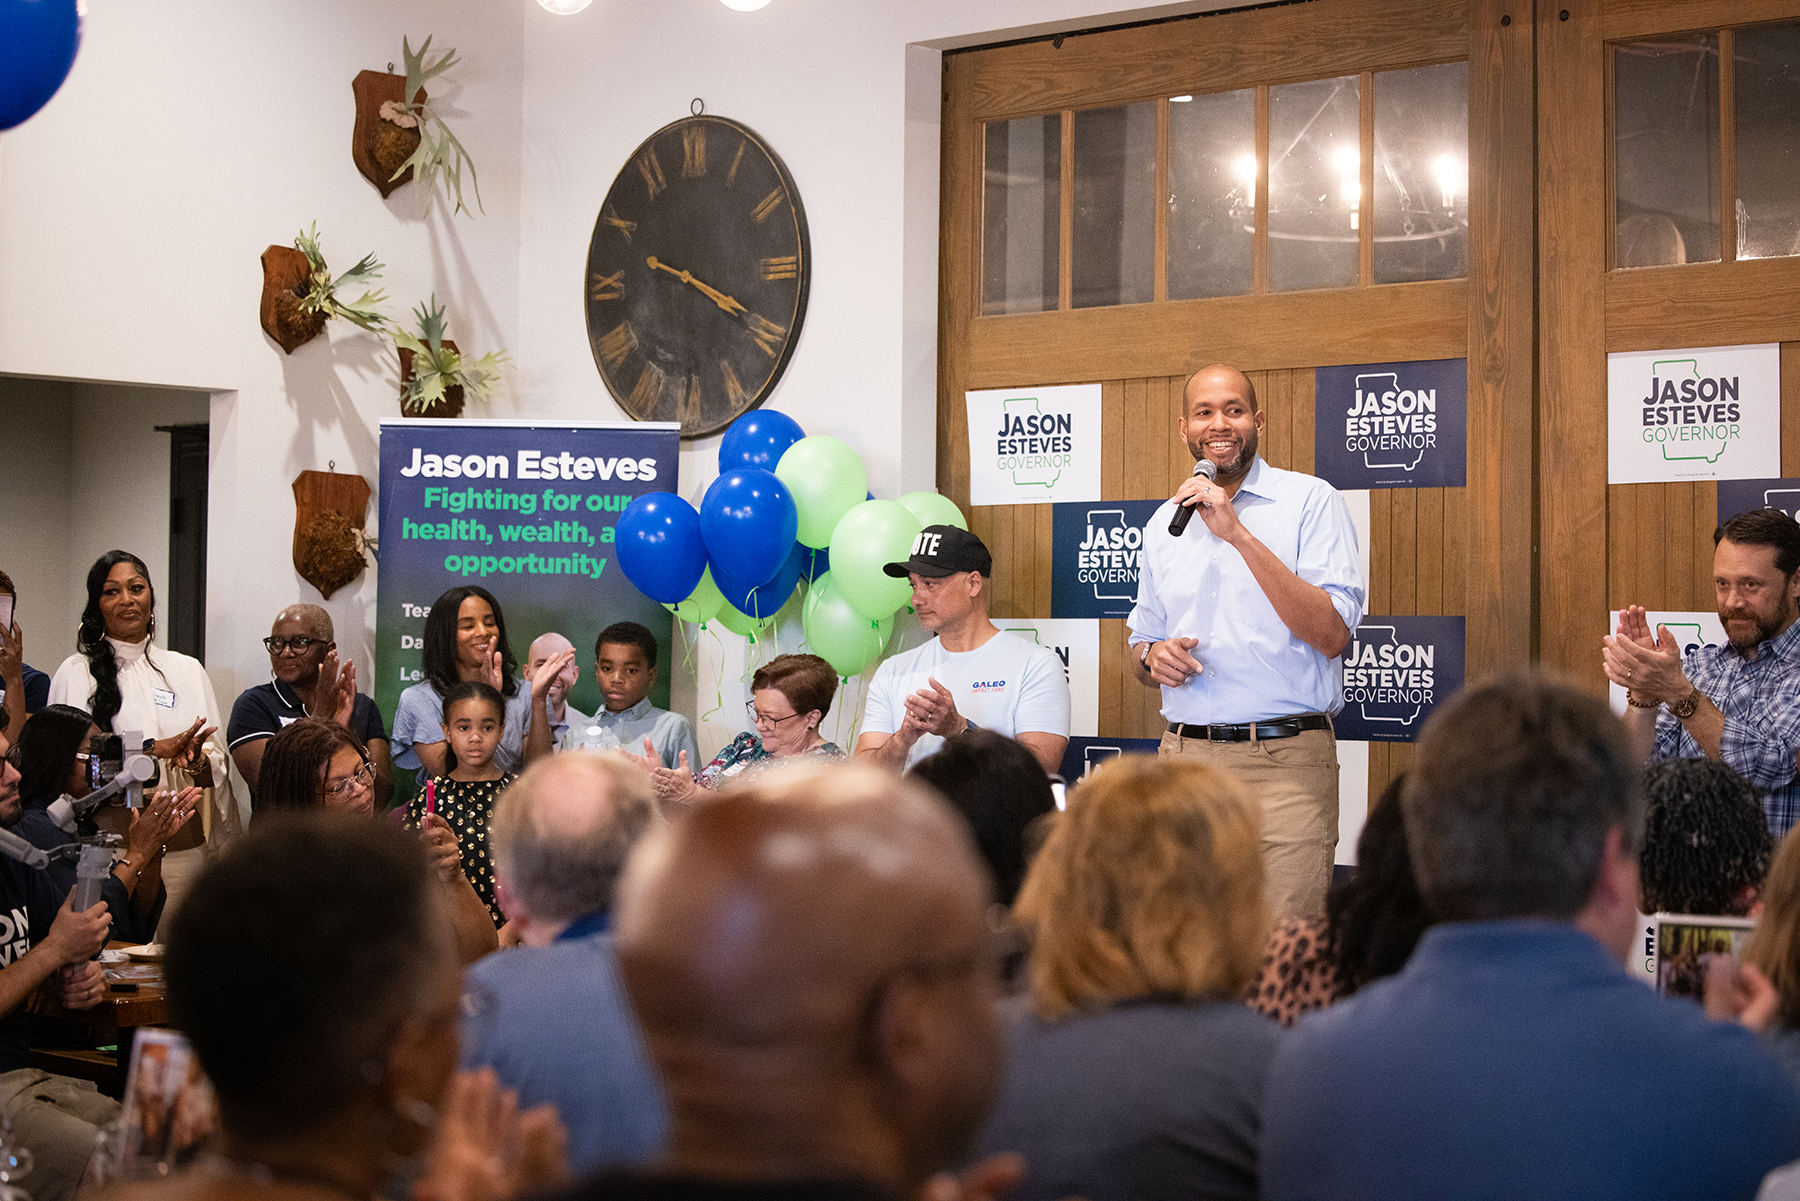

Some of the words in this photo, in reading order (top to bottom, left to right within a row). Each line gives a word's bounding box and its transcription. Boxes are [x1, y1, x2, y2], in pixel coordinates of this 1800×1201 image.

[751, 185, 786, 226] II
[760, 255, 797, 283] III
[1347, 389, 1436, 417] JASON
[1643, 377, 1739, 405] JASON
[997, 413, 1072, 437] JASON
[1346, 414, 1437, 436] ESTEVES
[1643, 403, 1741, 426] ESTEVES
[997, 436, 1072, 455] ESTEVES
[1346, 434, 1436, 452] GOVERNOR
[1642, 424, 1741, 443] GOVERNOR
[400, 448, 509, 478] Jason
[516, 450, 657, 481] Esteves
[997, 454, 1072, 470] GOVERNOR
[424, 487, 537, 515] Fighting
[542, 489, 581, 511] for
[586, 494, 632, 511] our
[402, 518, 493, 545] health,
[499, 521, 595, 547] wealth,
[909, 532, 942, 556] OTE
[444, 553, 607, 579] opportunity
[1344, 640, 1434, 668] JASON
[972, 680, 1006, 688] GALEO
[1343, 668, 1434, 688] ESTEVES
[1343, 688, 1433, 704] GOVERNOR
